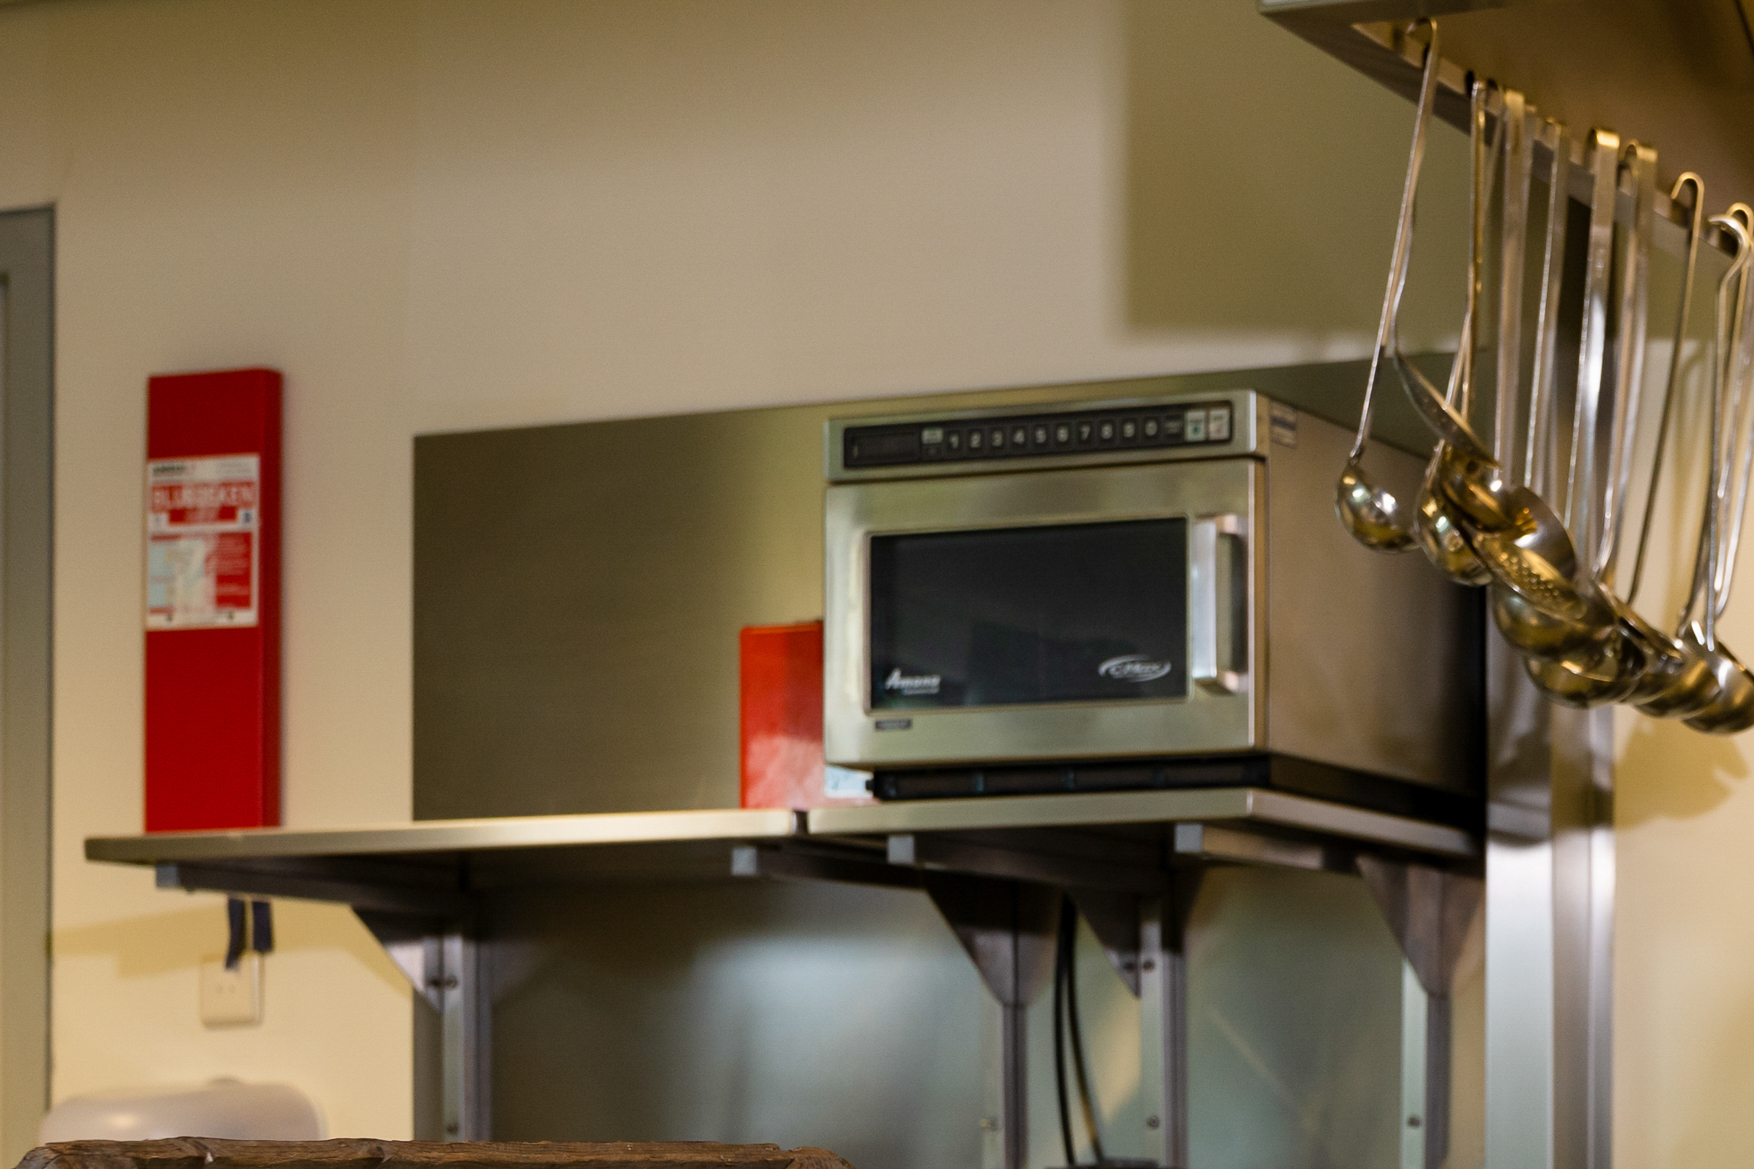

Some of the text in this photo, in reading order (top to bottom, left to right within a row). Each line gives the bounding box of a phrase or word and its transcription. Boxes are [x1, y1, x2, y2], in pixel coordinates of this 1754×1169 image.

[970, 431, 982, 448] 2
[991, 430, 1003, 447] 3
[1013, 428, 1026, 445] 4
[1035, 427, 1047, 444] 5
[1080, 424, 1091, 441] 7
[1101, 422, 1114, 440] 8
